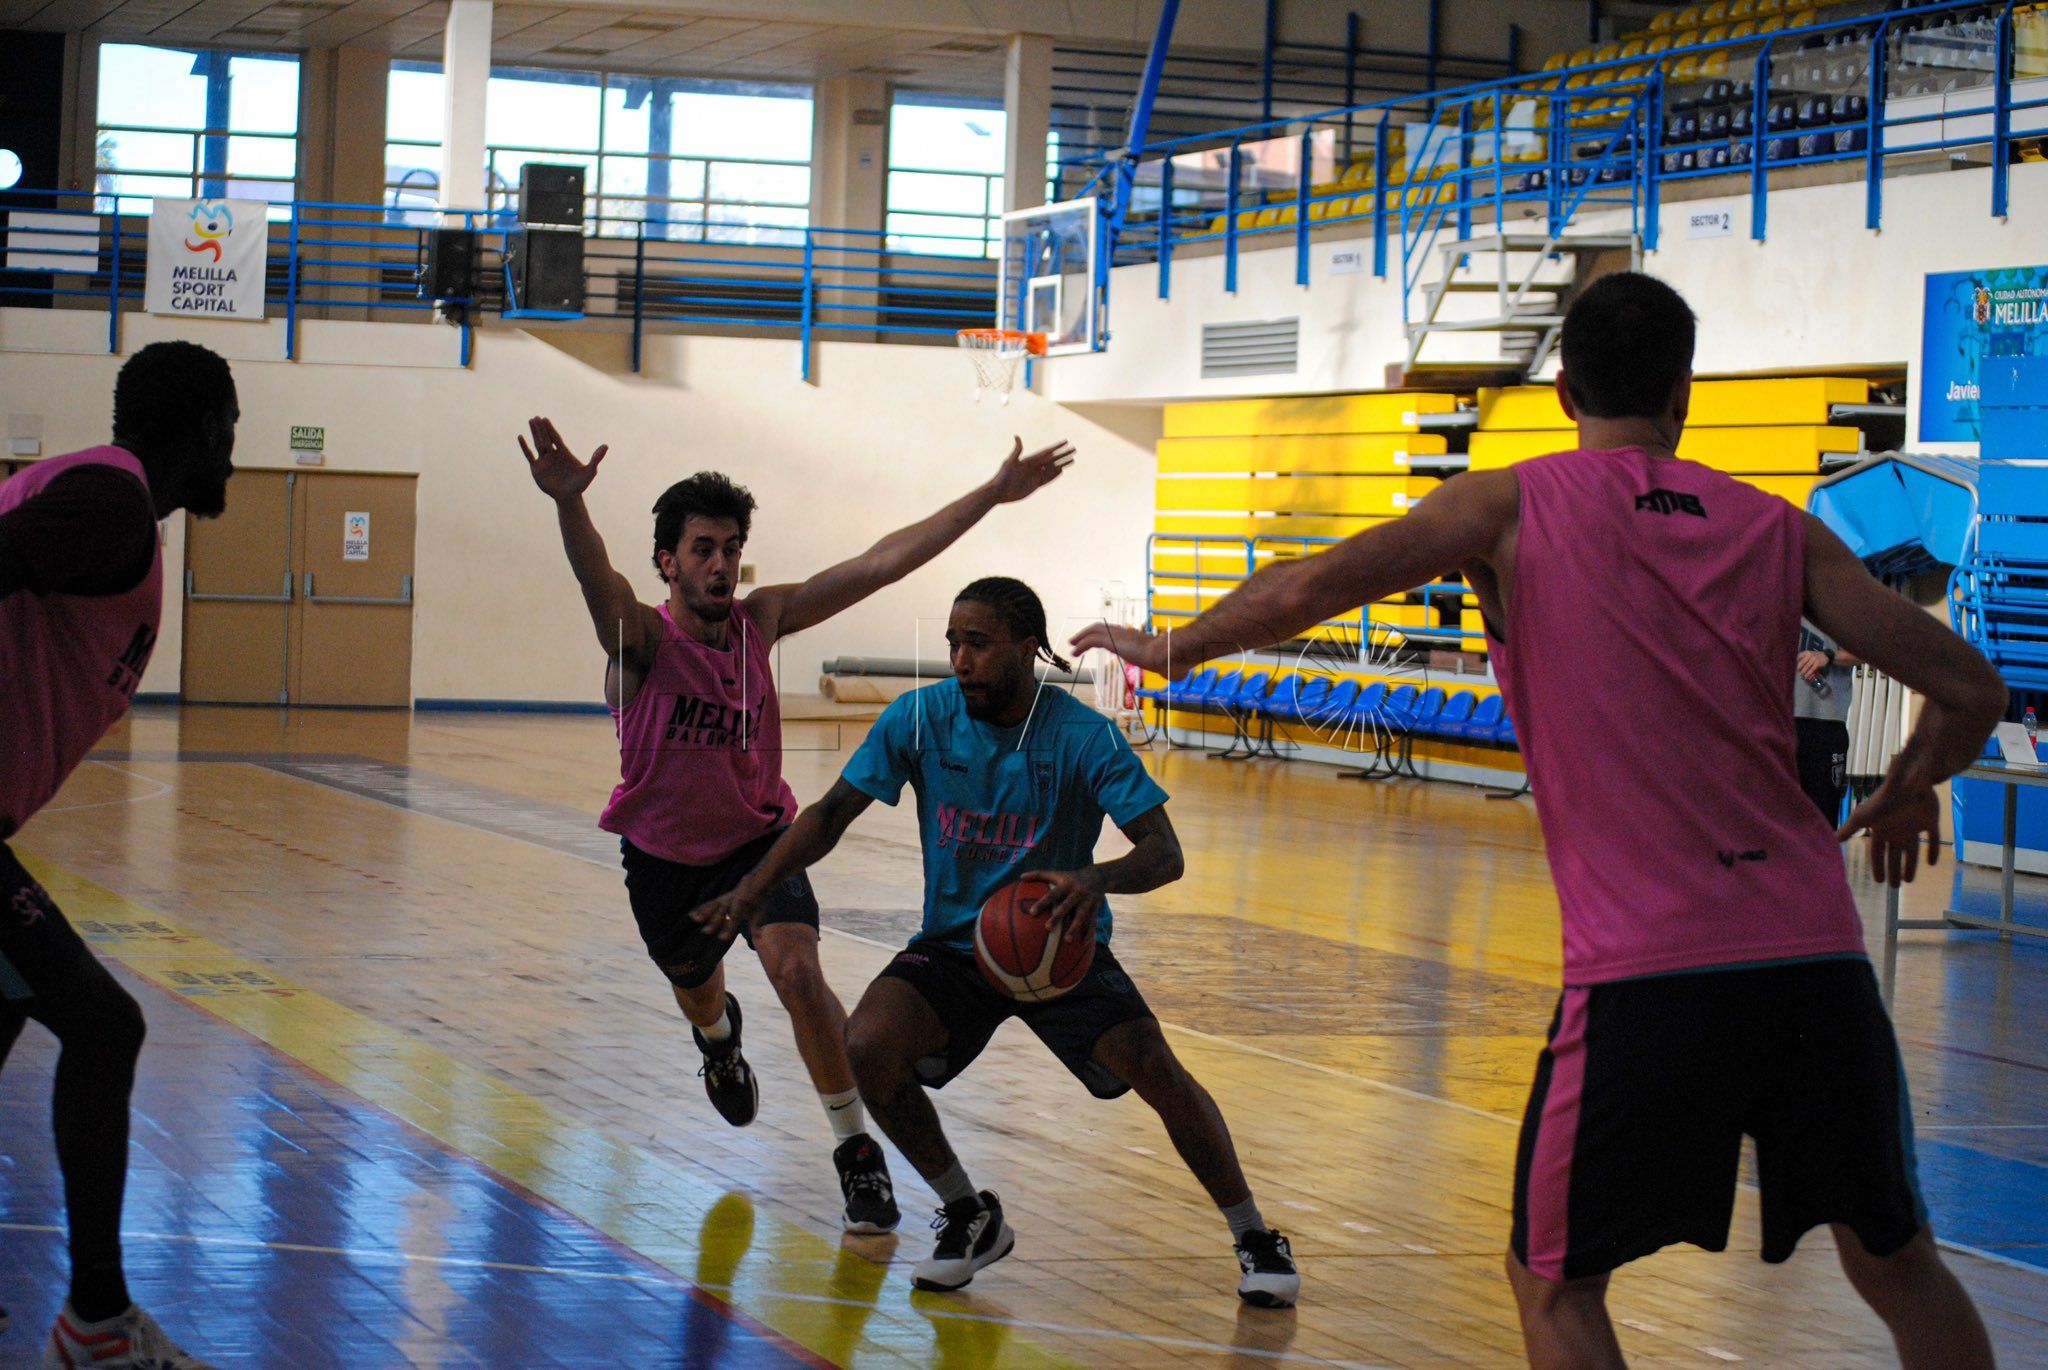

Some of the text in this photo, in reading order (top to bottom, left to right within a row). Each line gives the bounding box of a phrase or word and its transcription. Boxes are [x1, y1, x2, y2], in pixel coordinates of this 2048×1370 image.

[1691, 213, 1729, 230] SECTOR 2
[173, 266, 238, 282] MELILLA
[173, 281, 225, 296] SPORT
[1994, 290, 2016, 300] CIUDAD
[172, 297, 236, 312] CAPITAL
[1995, 302, 2048, 325] MELILLA
[292, 428, 323, 439] SALIDA
